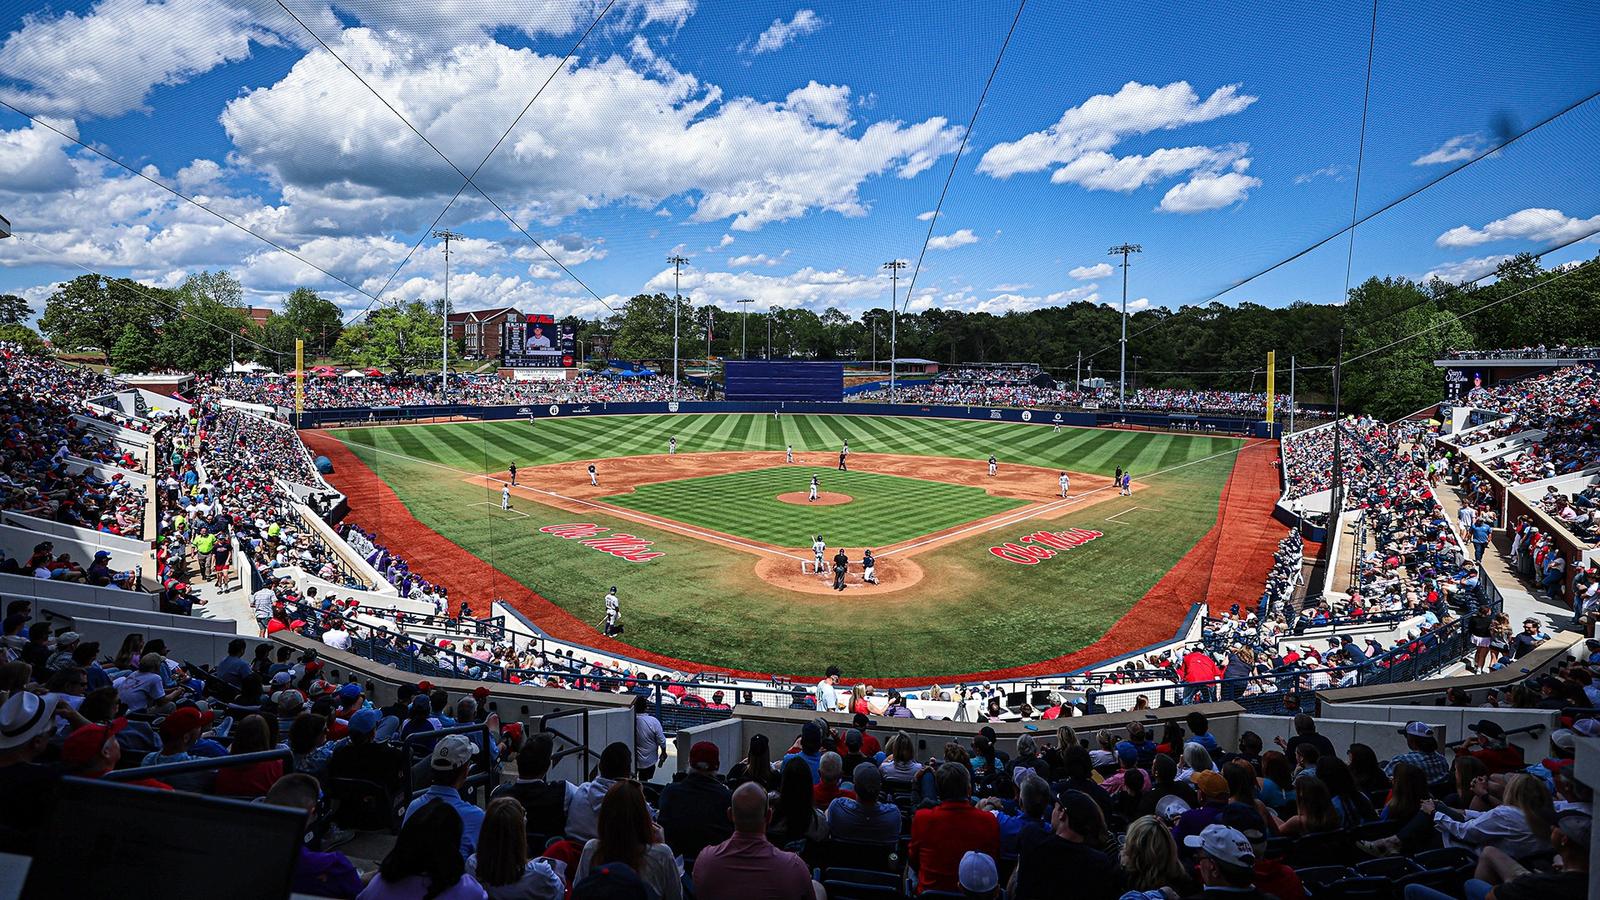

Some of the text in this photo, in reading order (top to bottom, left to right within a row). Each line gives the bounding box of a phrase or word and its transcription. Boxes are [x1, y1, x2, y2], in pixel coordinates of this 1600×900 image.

[539, 523, 666, 562] Ole Miss
[989, 527, 1103, 565] Ole Miss
